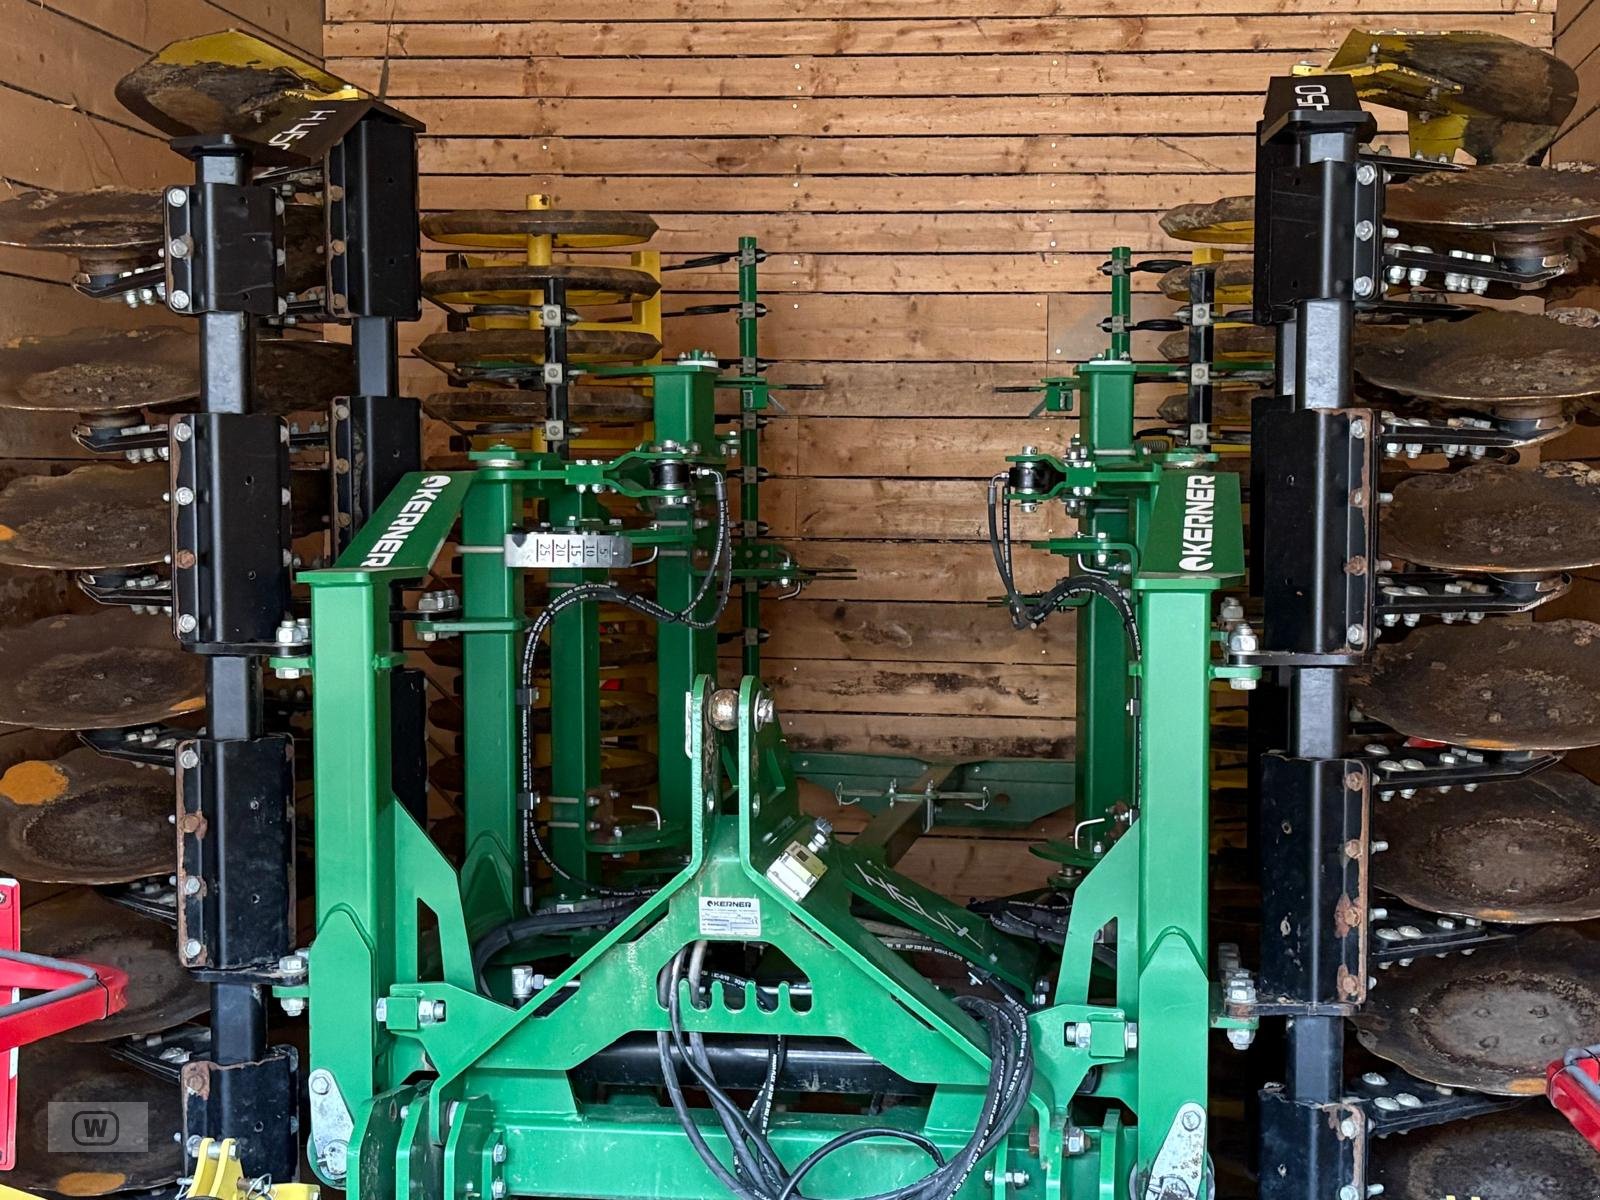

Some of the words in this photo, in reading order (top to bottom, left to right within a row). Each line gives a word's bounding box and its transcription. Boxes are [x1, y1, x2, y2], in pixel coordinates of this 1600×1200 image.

[1181, 474, 1216, 556] KERNER
[360, 488, 443, 567] KERNER
[539, 543, 551, 558] 25
[555, 543, 567, 557] 20
[570, 544, 581, 557] 15
[585, 544, 595, 558] 10
[713, 900, 752, 908] KERNER
